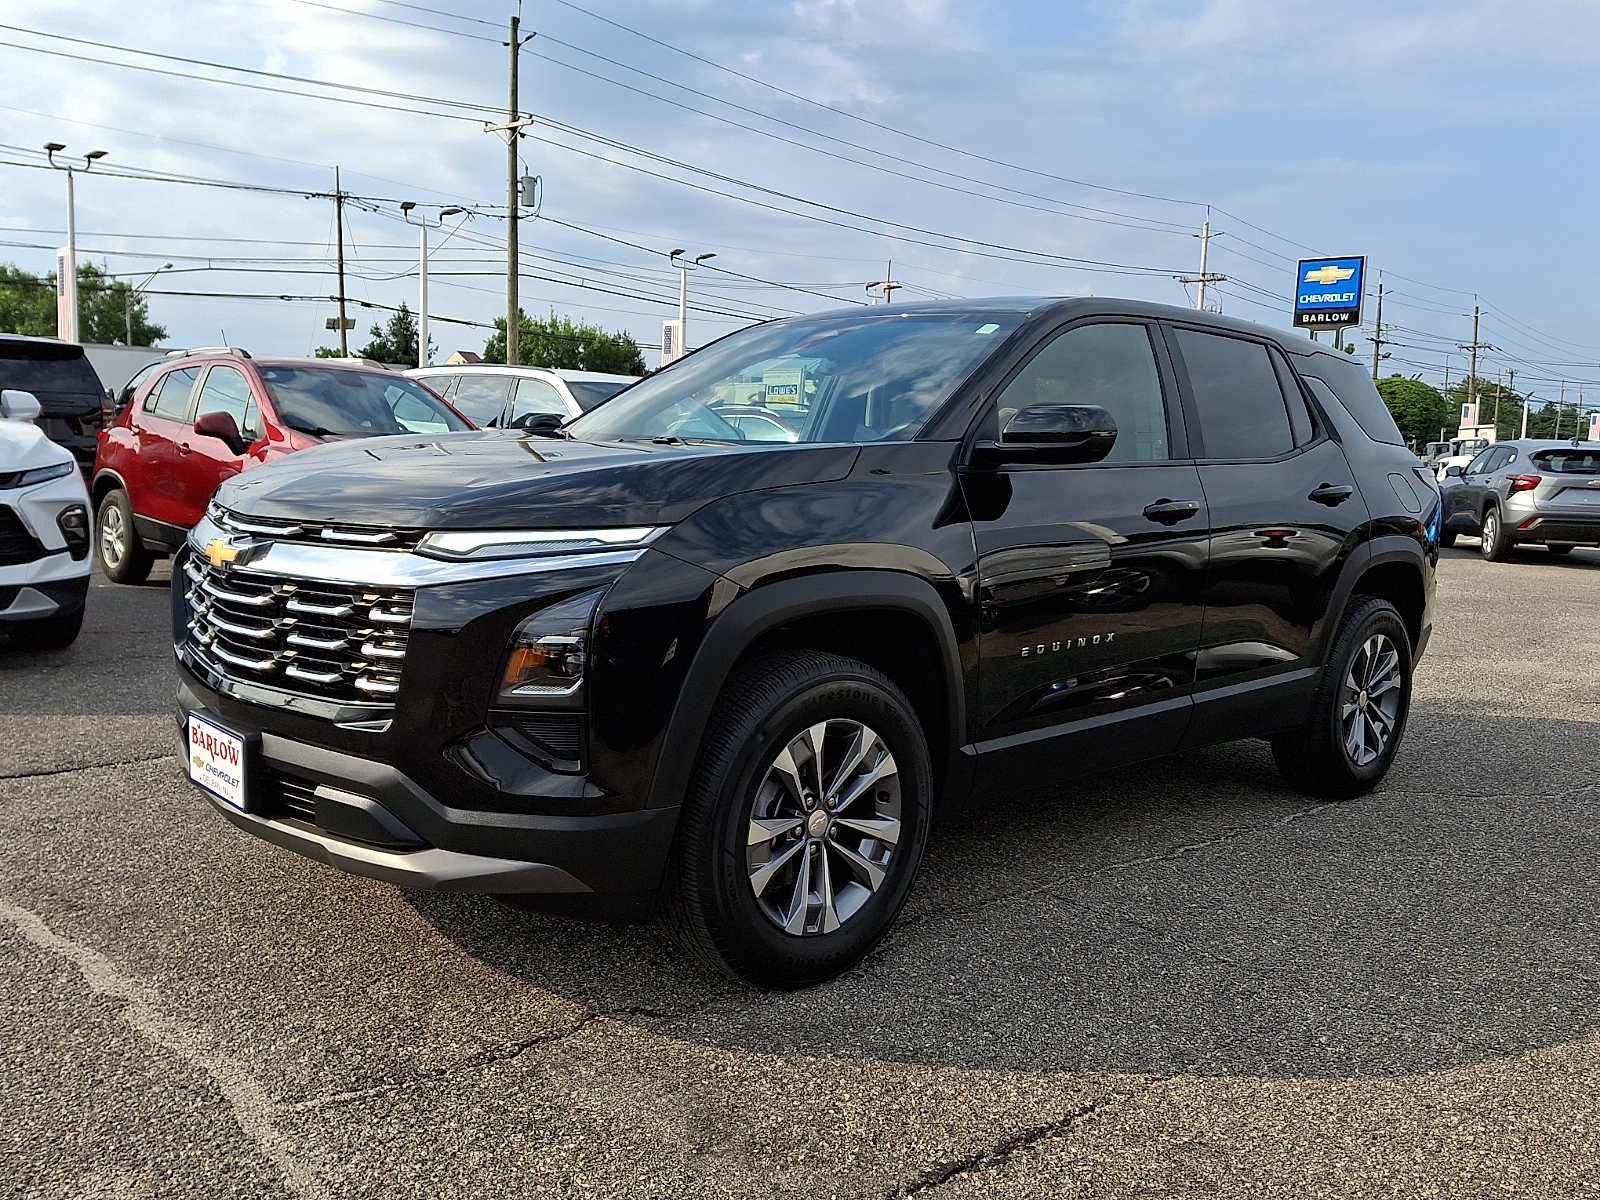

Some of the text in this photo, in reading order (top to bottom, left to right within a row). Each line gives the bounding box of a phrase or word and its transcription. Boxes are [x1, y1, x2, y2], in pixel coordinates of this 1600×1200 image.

[1299, 292, 1355, 304] CHEVROLET
[1302, 312, 1350, 322] BARLOW
[768, 385, 797, 395] LOWE'S
[1021, 632, 1115, 657] EQUINOX
[191, 726, 240, 767] BARLOW
[205, 763, 240, 789] CHEVROLET
